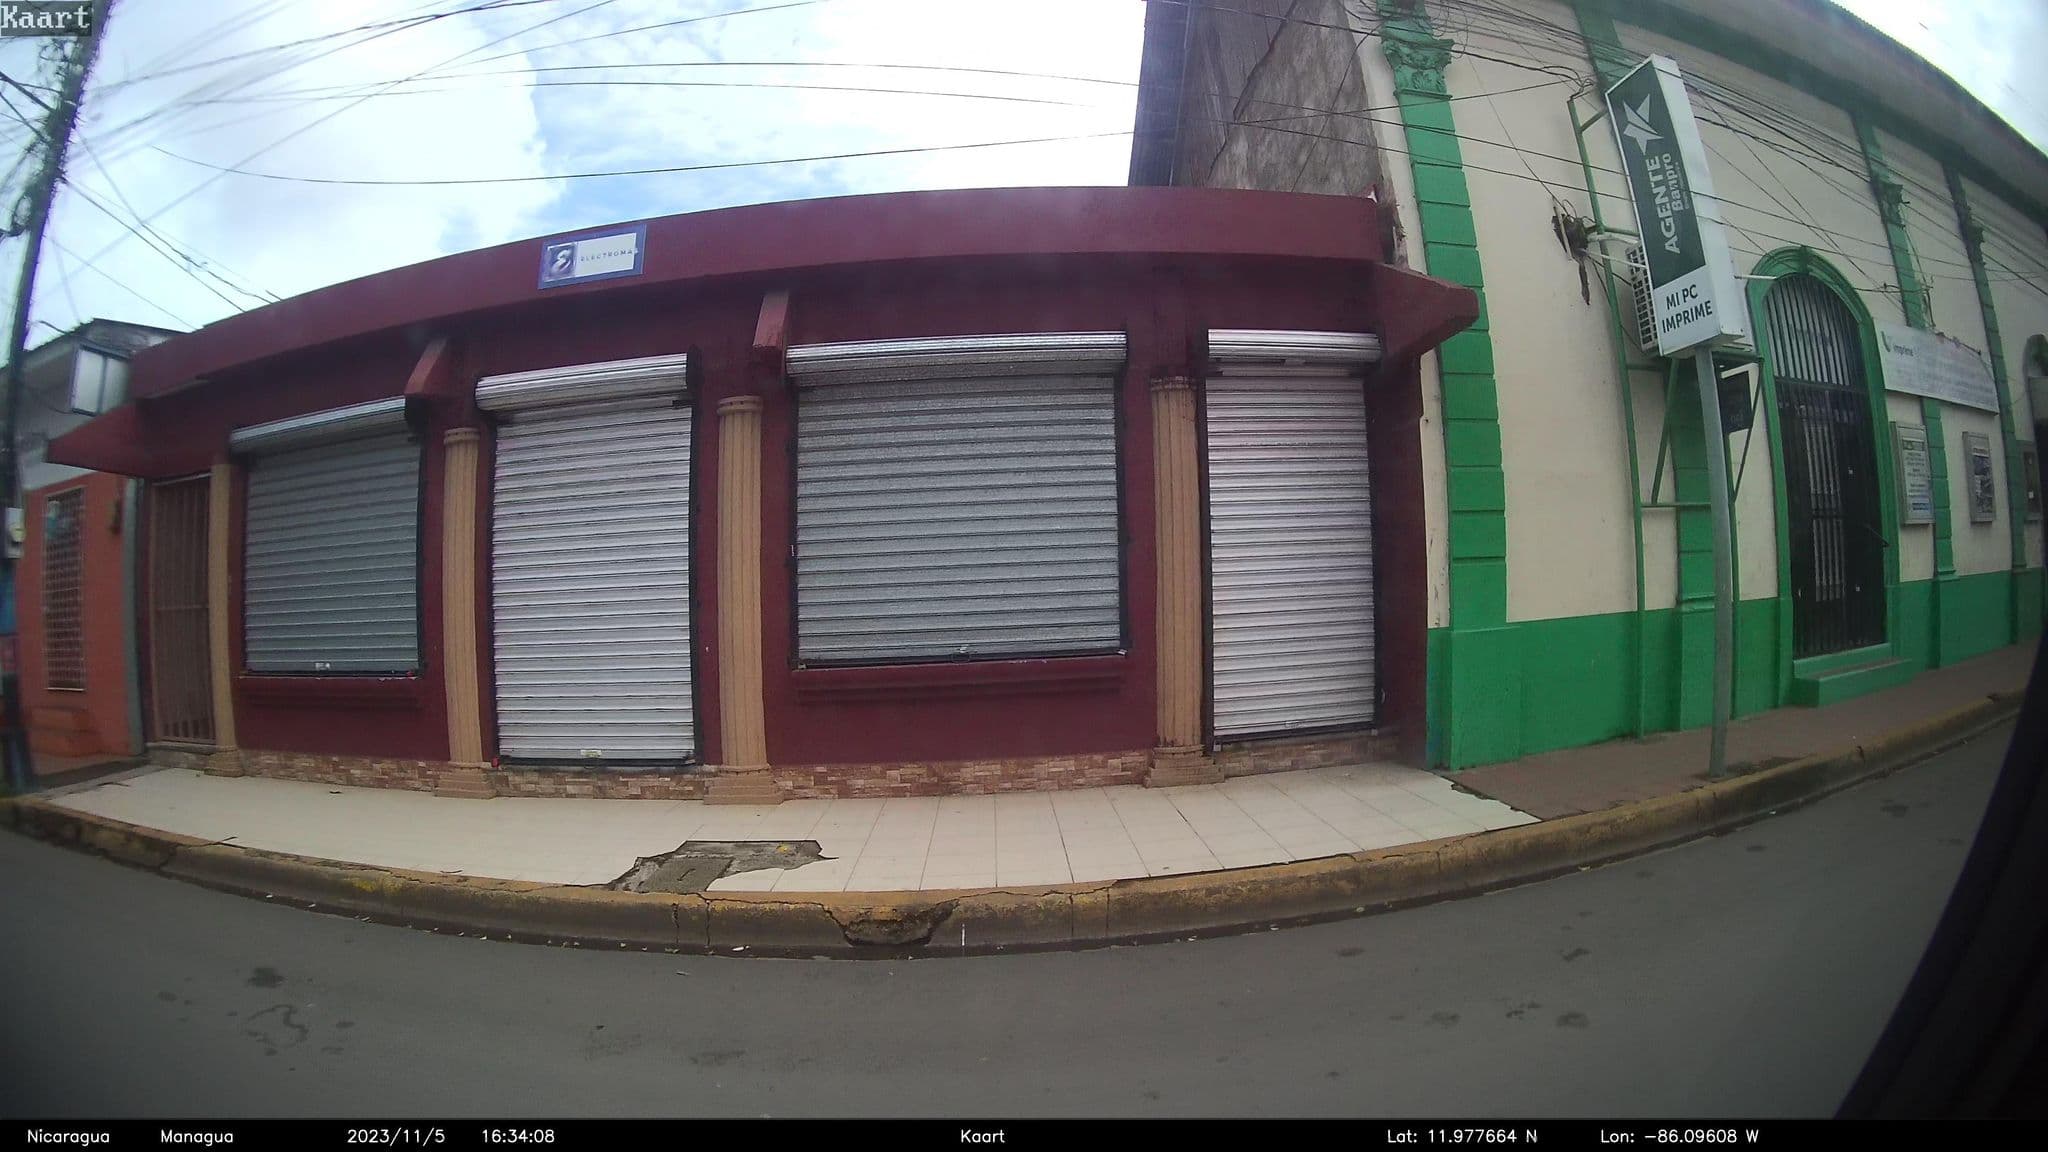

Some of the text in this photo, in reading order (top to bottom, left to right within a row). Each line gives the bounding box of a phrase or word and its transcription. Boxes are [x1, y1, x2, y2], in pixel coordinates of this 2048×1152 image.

[1645, 155, 1681, 254] AGENTE
[1662, 153, 1684, 212] Banpro
[1661, 299, 1713, 334] IMPRIME
[1665, 284, 1699, 311] MI PC
